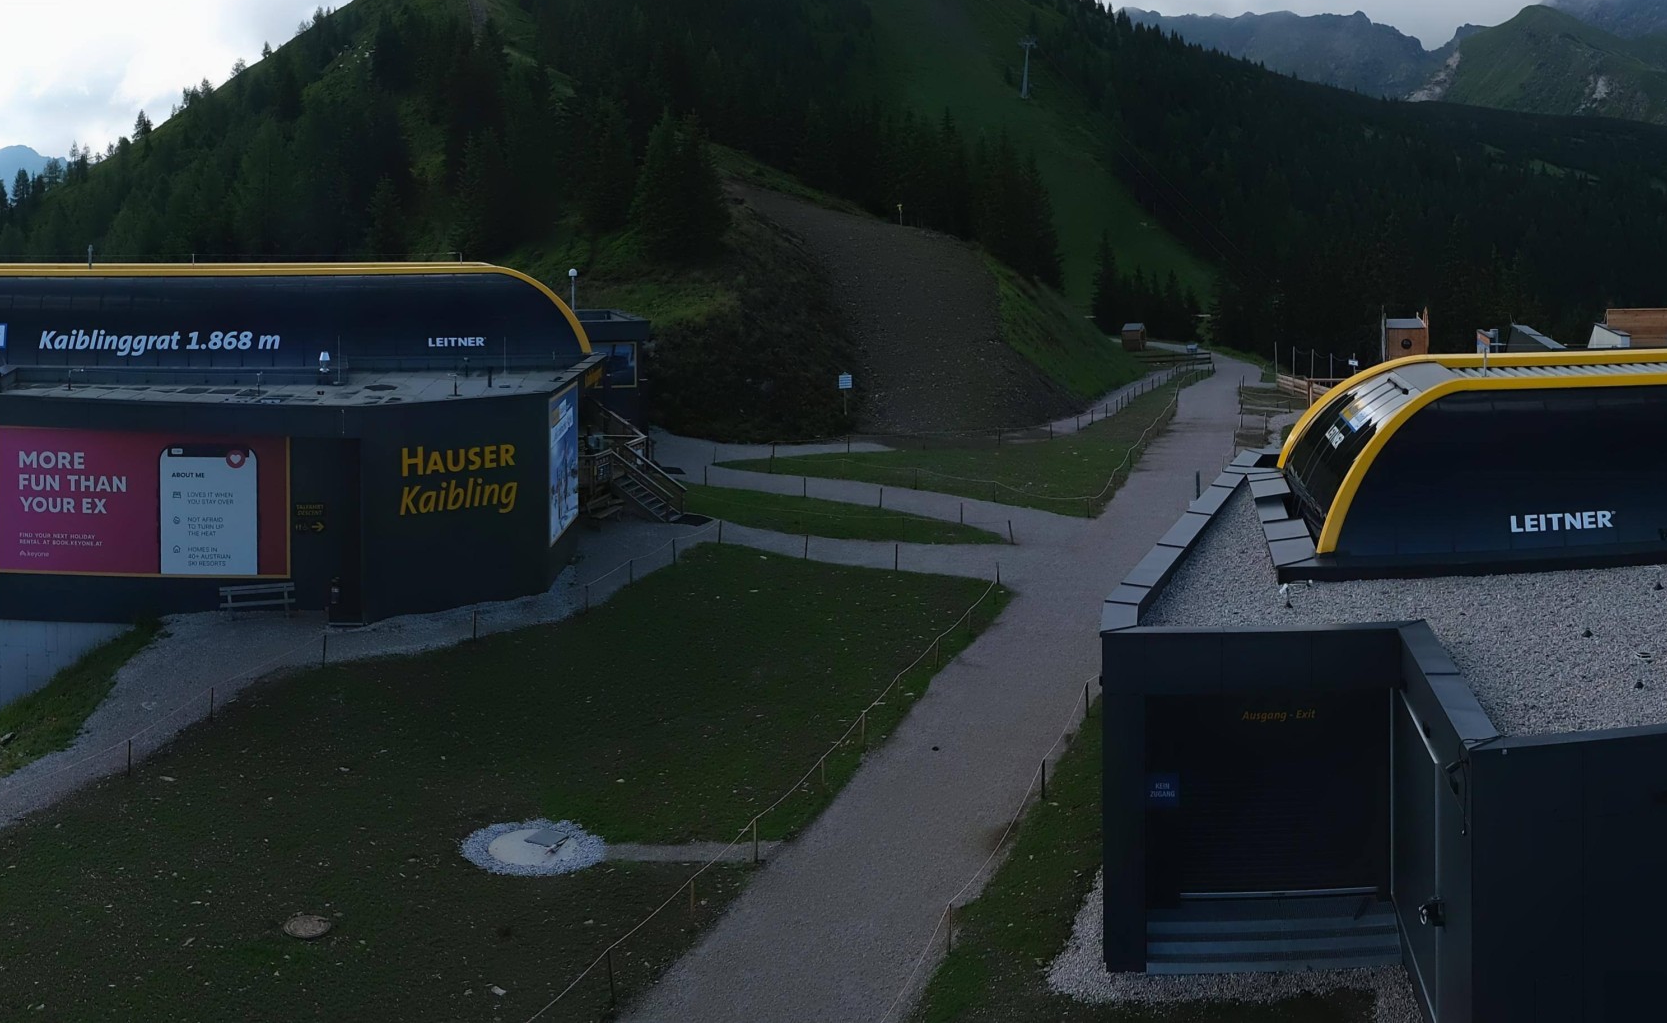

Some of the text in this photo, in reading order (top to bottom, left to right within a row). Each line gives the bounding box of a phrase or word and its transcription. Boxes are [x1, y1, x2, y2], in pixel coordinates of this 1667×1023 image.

[38, 330, 281, 357] Kaiblinggrat 1.868 m
[428, 337, 485, 347] LEITNER
[18, 451, 85, 469] MORE
[401, 443, 516, 477] HAUSER
[18, 473, 127, 493] FUN THAN
[20, 496, 108, 514] YOUR EX
[399, 477, 518, 516] Kaibling
[1510, 511, 1614, 533] LEITNER
[1242, 711, 1288, 723] Ausgang
[1296, 709, 1316, 719] Exit
[1150, 790, 1176, 798] ZUGANG
